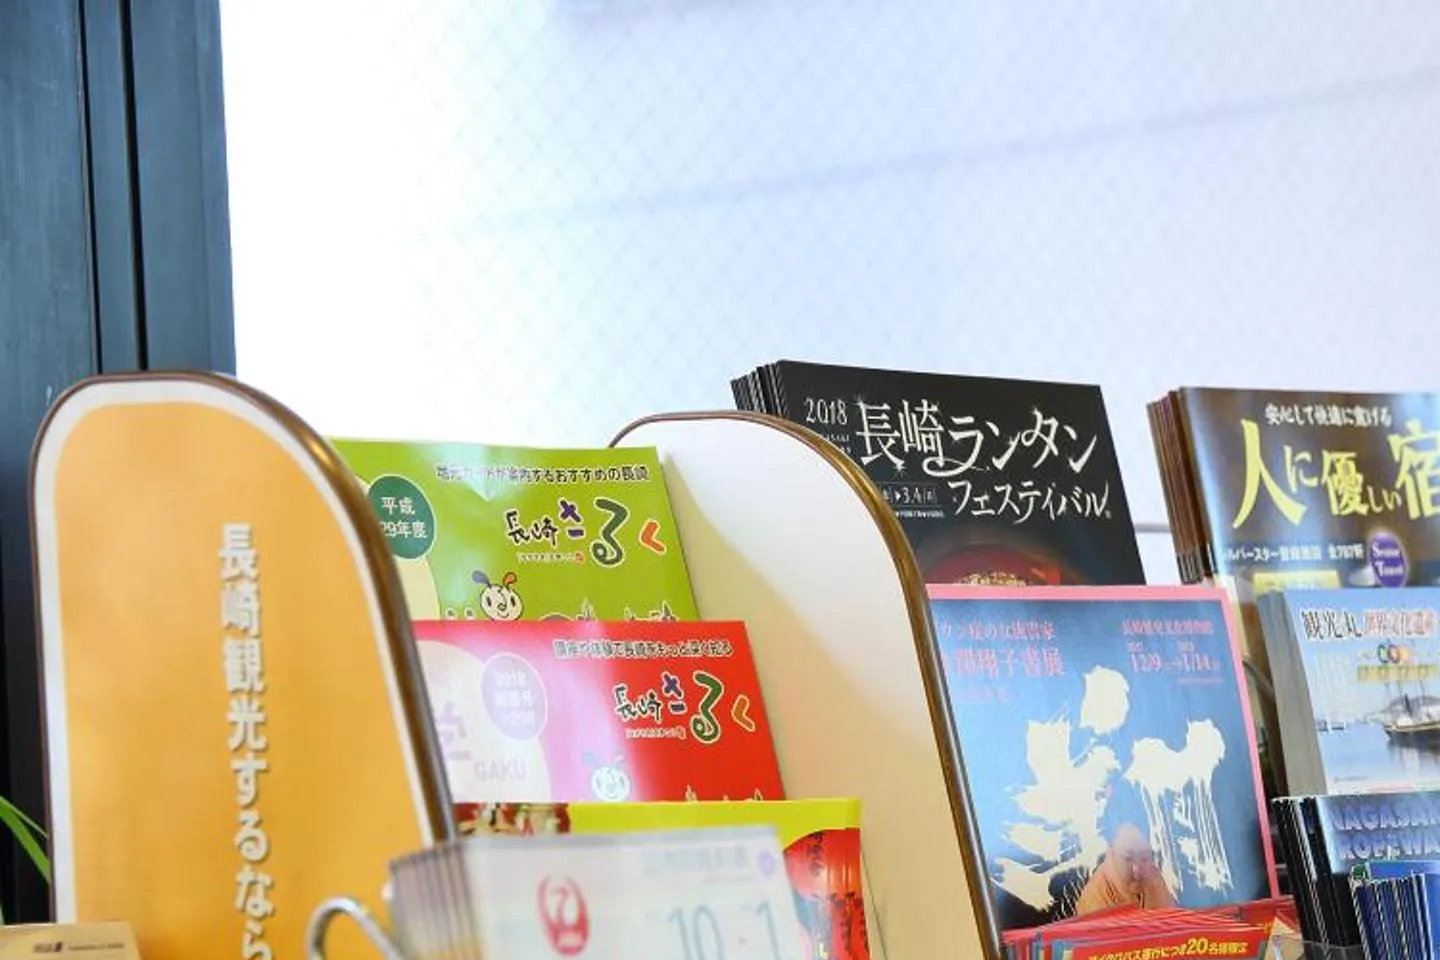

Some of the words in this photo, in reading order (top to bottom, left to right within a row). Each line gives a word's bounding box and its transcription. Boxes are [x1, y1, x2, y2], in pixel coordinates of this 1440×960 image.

[805, 397, 848, 425] 2018
[855, 398, 1097, 477] 長崎ランタン
[380, 497, 416, 516] 平成
[948, 480, 1108, 524] フェスティバル
[505, 498, 666, 567] 長崎さるく
[613, 670, 756, 743] 長崎さるく
